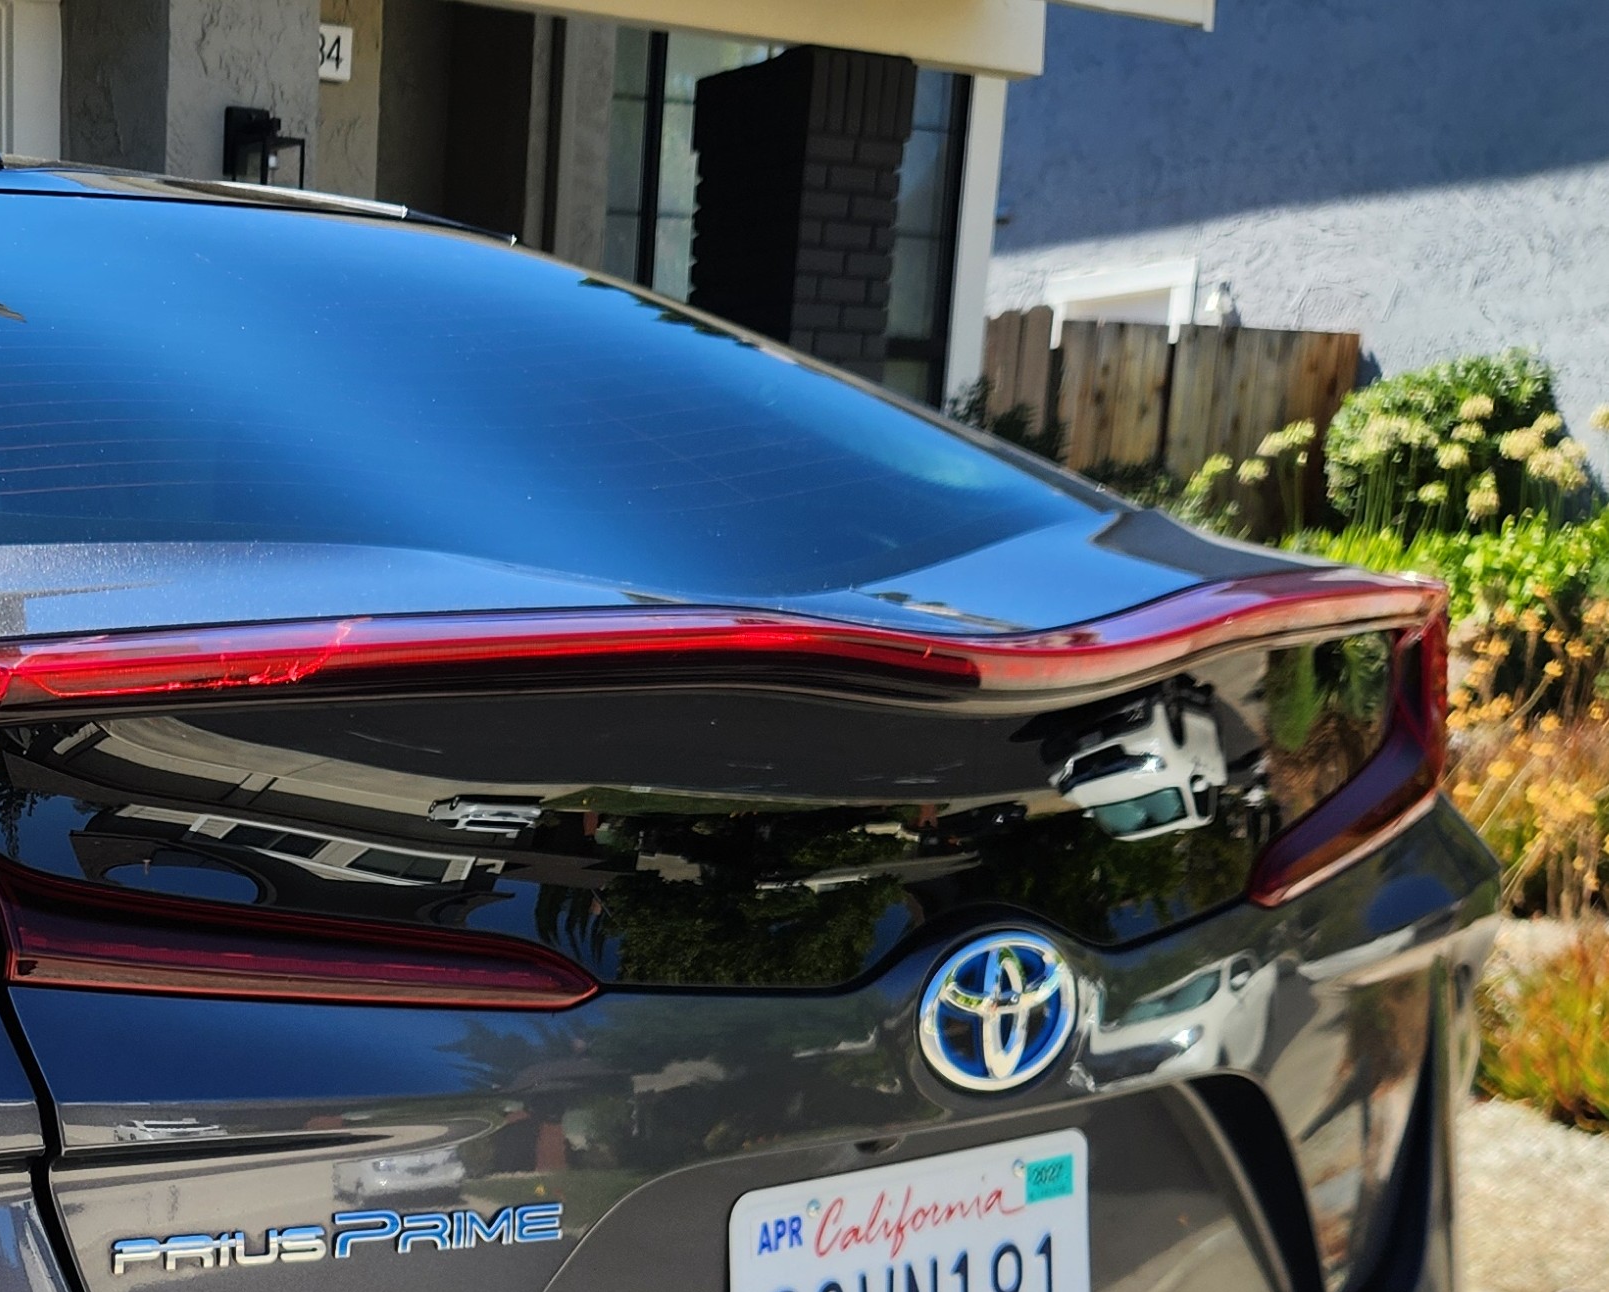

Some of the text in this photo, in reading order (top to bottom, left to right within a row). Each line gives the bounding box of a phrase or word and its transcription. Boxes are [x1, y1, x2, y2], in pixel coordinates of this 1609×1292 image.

[112, 1202, 564, 1276] PRIUS PRIME
[757, 1215, 803, 1256] APR
[814, 1184, 1026, 1258] California
